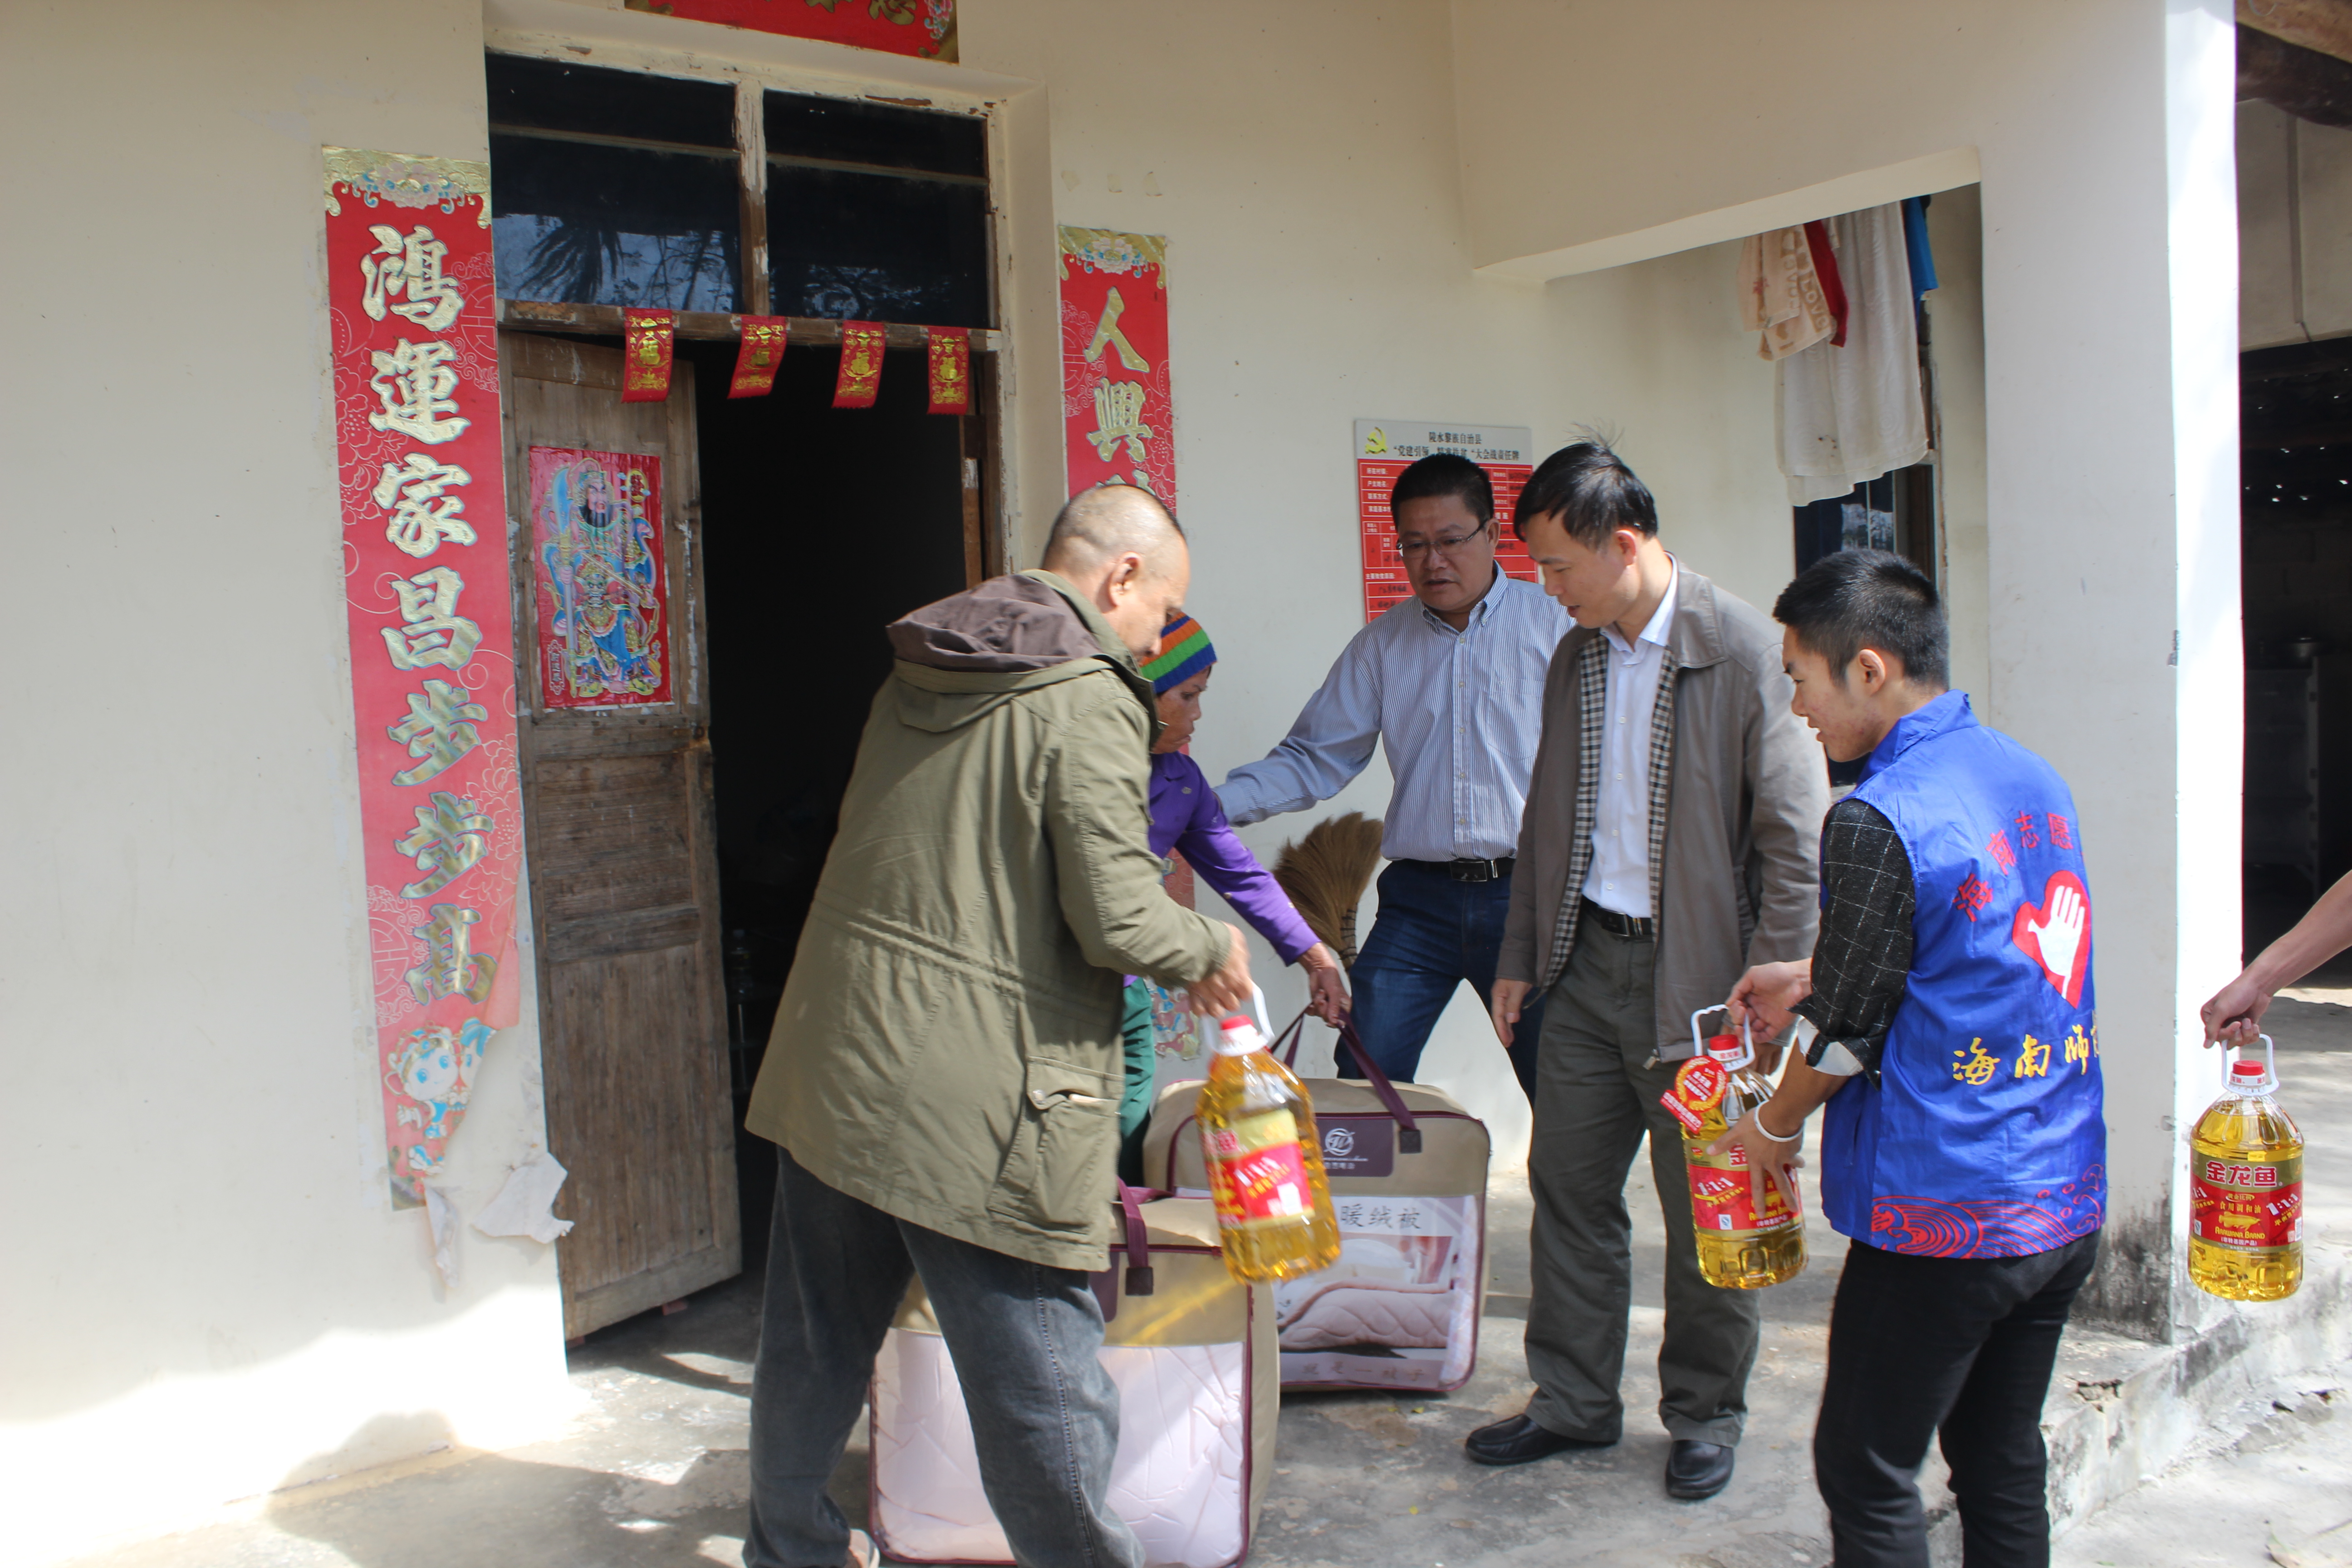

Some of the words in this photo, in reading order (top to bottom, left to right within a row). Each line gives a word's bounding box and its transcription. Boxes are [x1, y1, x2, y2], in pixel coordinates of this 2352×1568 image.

[1083, 286, 1156, 495] 人興
[1429, 431, 1482, 445] 陵水黎族自治县
[1953, 1016, 2100, 1086] 海南师
[2206, 1160, 2277, 1188] 金龙鱼
[1341, 1204, 1421, 1229] 暖绒被
[2220, 1201, 2261, 1214] 食用调和油
[2266, 1193, 2299, 1216] 1:1:1
